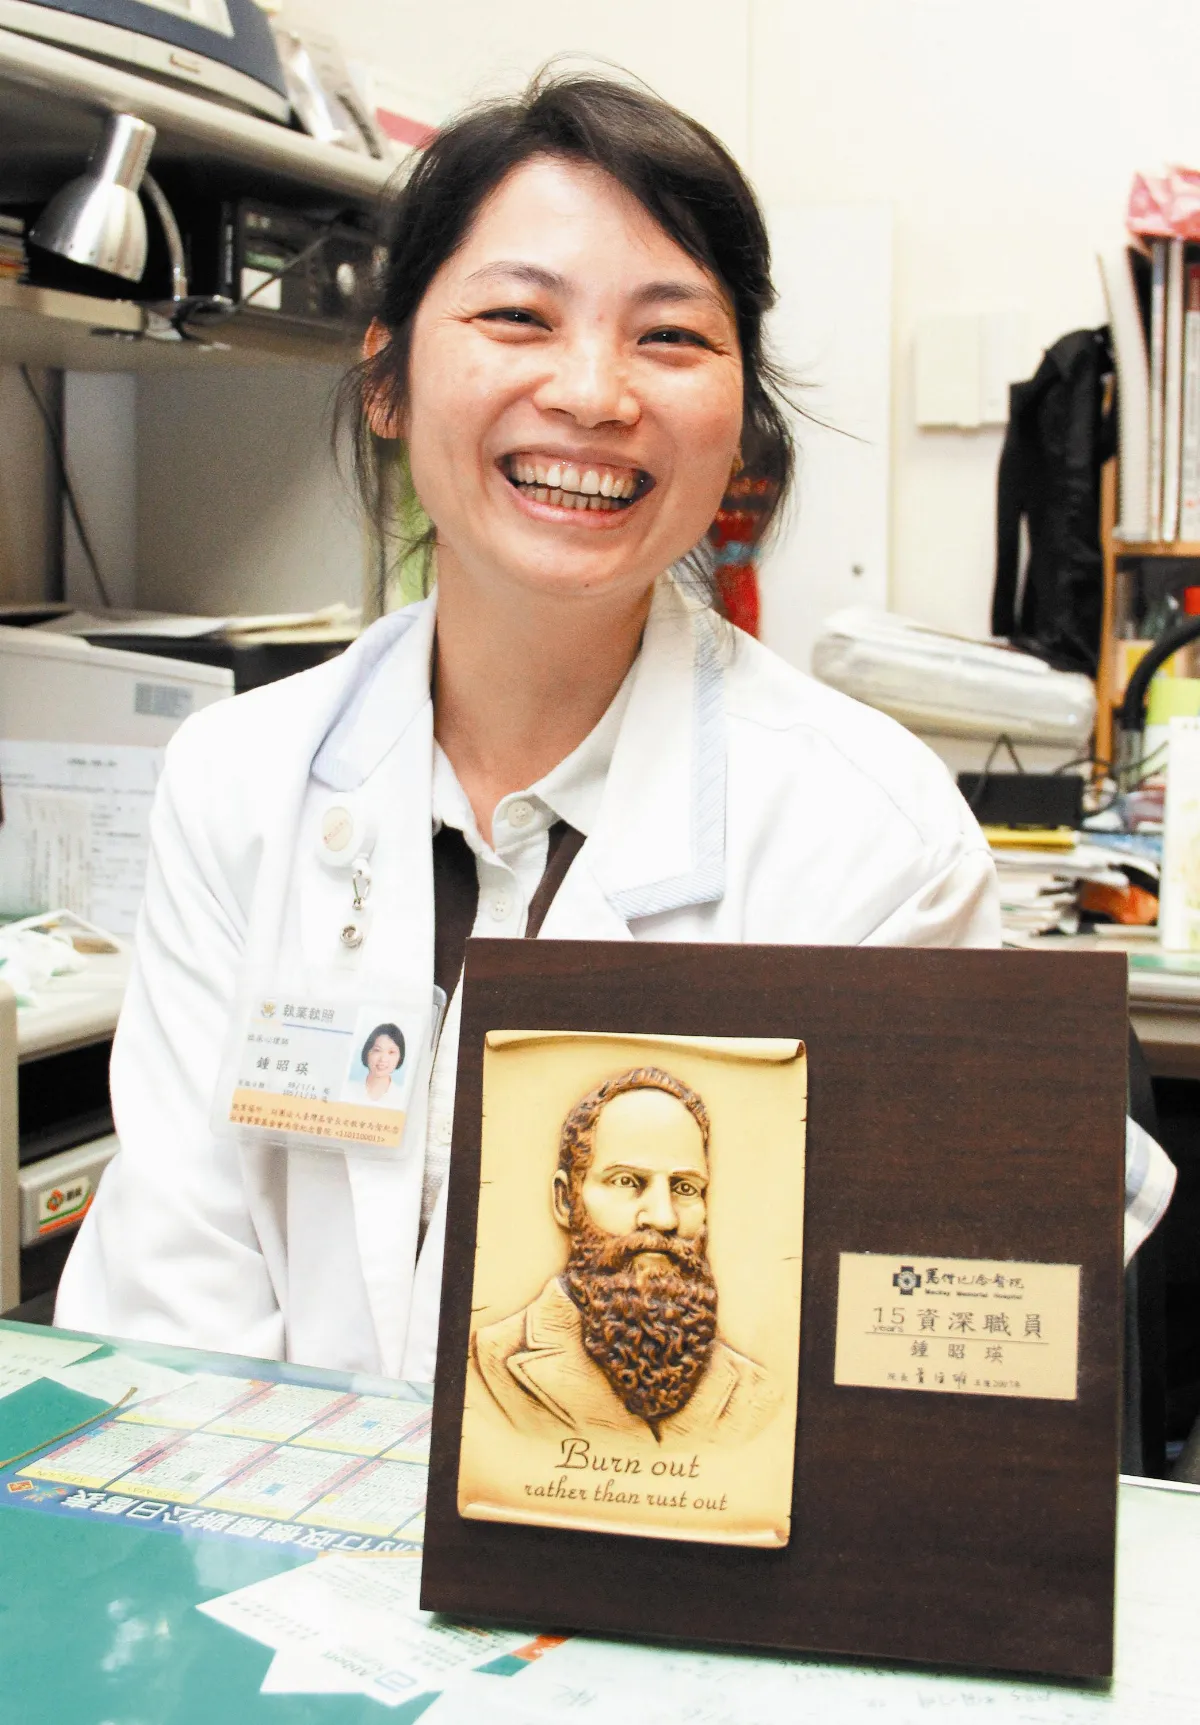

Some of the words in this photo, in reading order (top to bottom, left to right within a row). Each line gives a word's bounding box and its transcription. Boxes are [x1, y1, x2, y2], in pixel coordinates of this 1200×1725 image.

[873, 1307, 905, 1325] 15
[917, 1308, 1043, 1338] 資深職員
[554, 1437, 642, 1474] Burn
[651, 1454, 701, 1478] out
[524, 1474, 588, 1500] rather
[593, 1478, 640, 1504] than
[646, 1490, 688, 1508] rust
[692, 1493, 728, 1511] out
